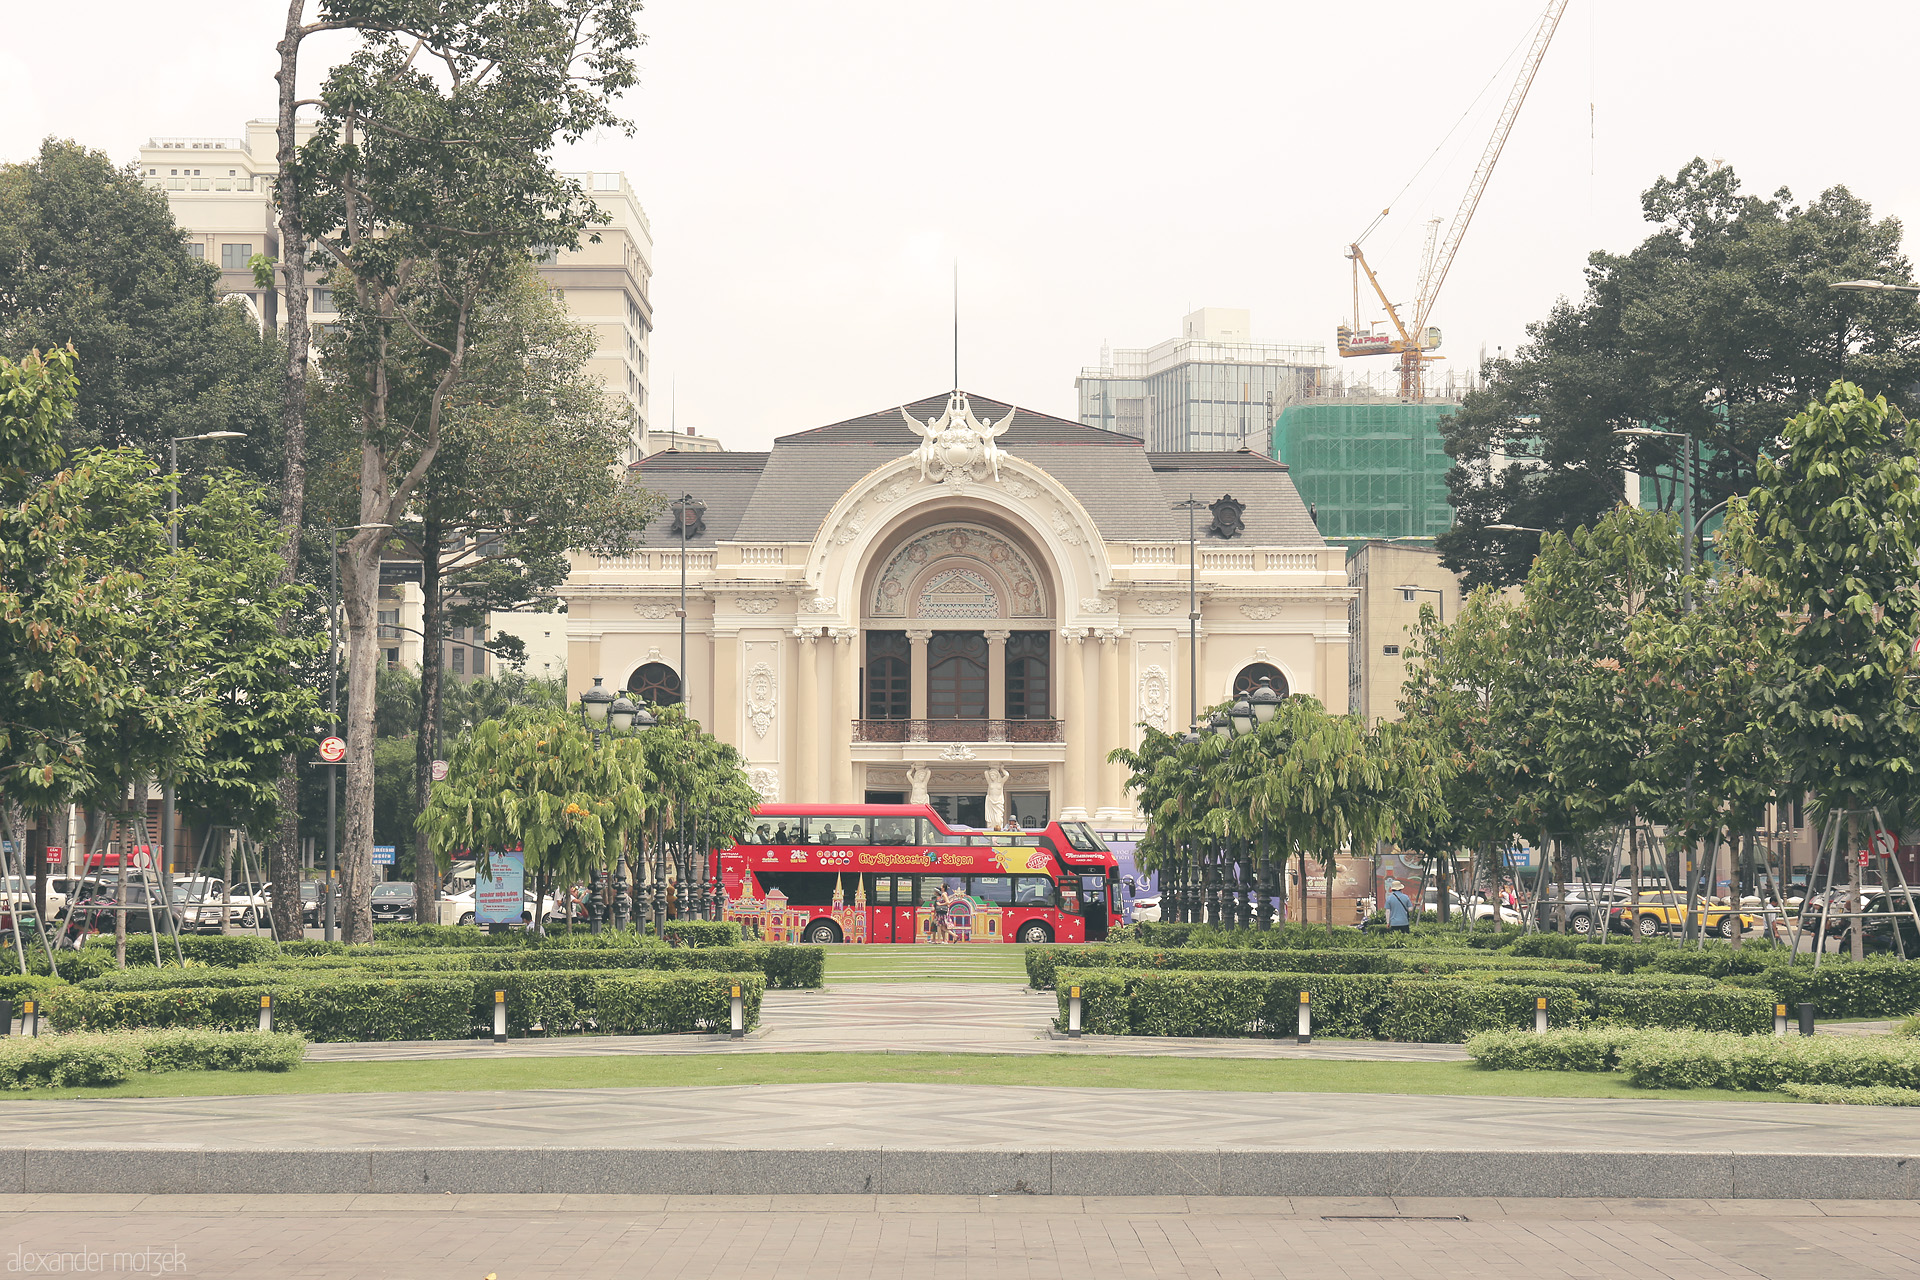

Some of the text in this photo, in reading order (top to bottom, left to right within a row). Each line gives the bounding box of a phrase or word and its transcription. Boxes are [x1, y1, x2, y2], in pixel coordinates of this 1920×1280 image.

[1363, 336, 1389, 344] Phong
[877, 852, 931, 867] Sightseeing
[942, 853, 974, 867] Saigon
[1027, 855, 1050, 867] OFFICIAL
